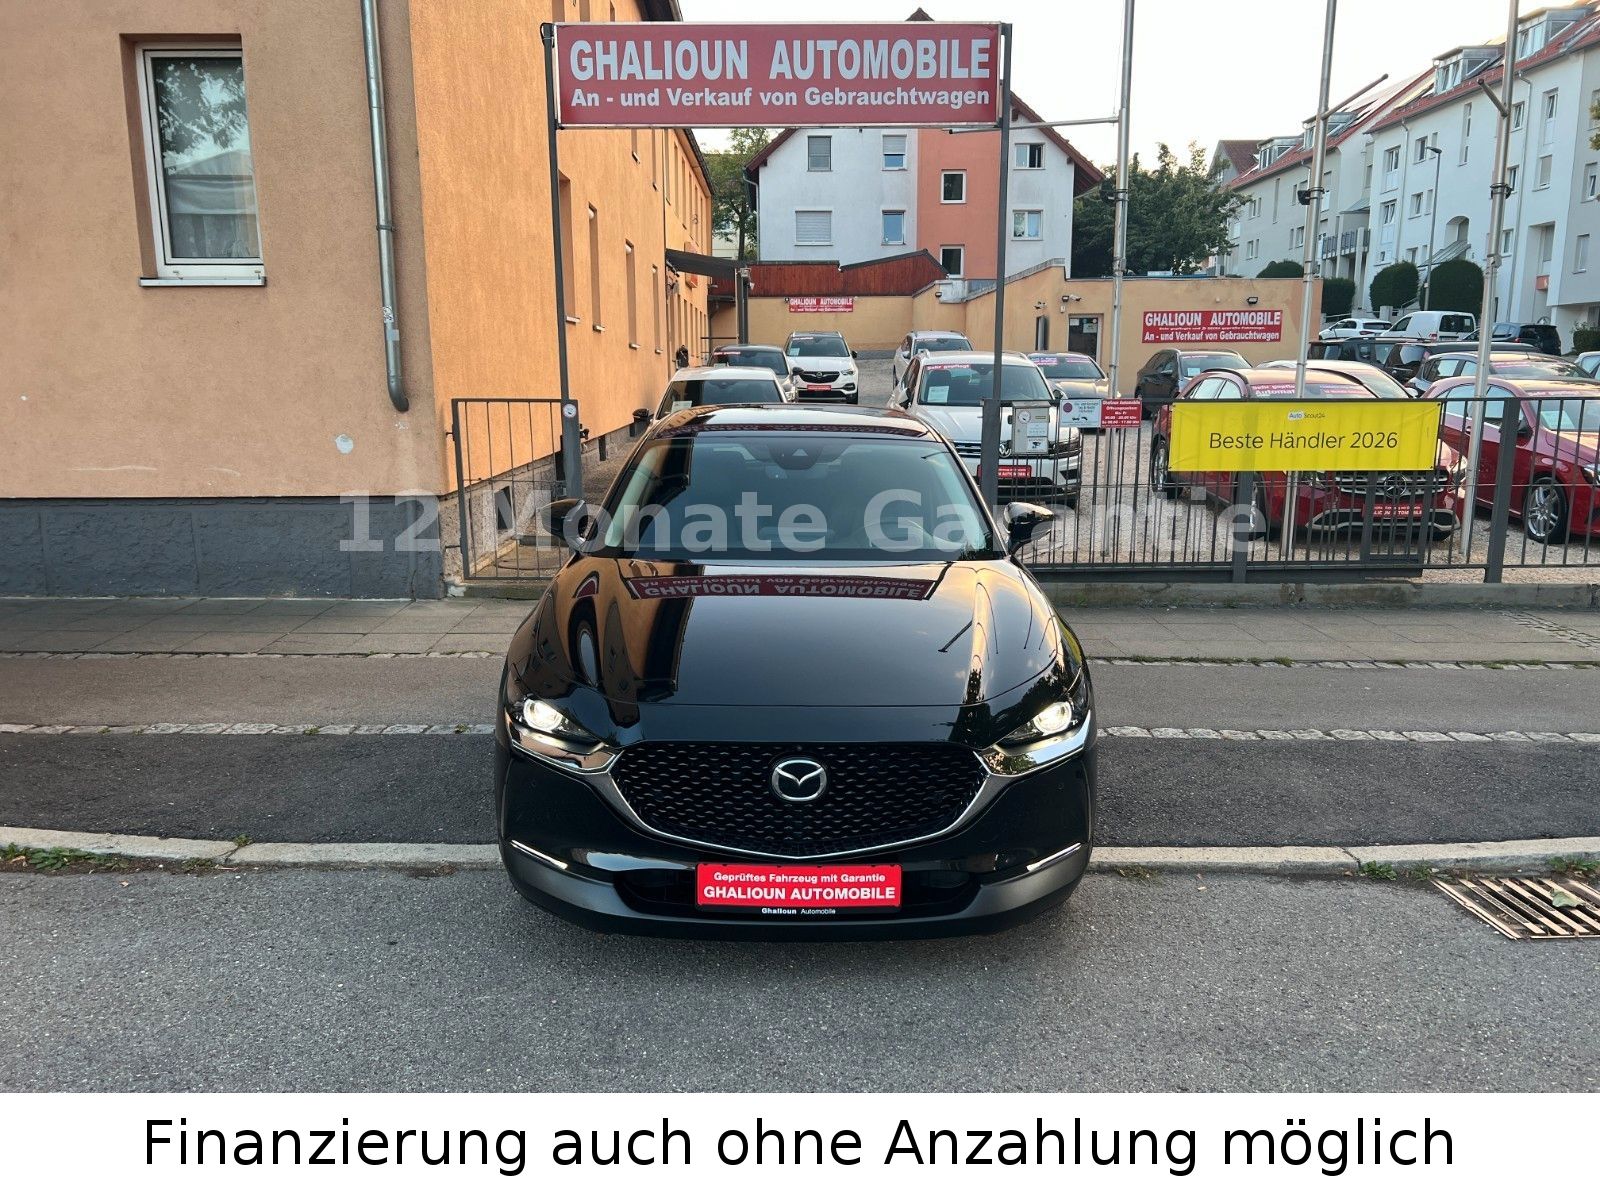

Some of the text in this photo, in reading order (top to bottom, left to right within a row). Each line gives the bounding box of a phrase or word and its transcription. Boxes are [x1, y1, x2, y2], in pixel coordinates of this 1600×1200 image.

[570, 38, 990, 81] GHALIOUN AUTOMOBILE
[571, 88, 599, 107] An
[620, 88, 660, 107] und
[666, 87, 753, 106] Verkauf
[759, 91, 797, 106] von
[804, 87, 990, 109] Gebrauchtwagen
[1145, 311, 1281, 326] GHALIOUN AUTOMOBILE
[1144, 331, 1154, 340] An
[1161, 331, 1174, 340] und
[1175, 331, 1203, 340] Verkauf
[1220, 331, 1280, 341] Gebrauchtwagen
[1210, 431, 1398, 449] Beste Händler 2026
[714, 872, 886, 884] Geprüftes Fahrzeug mit Garantie
[704, 886, 896, 900] GHALIOUN AUTOMOBILE
[761, 907, 797, 915] Ghalioun
